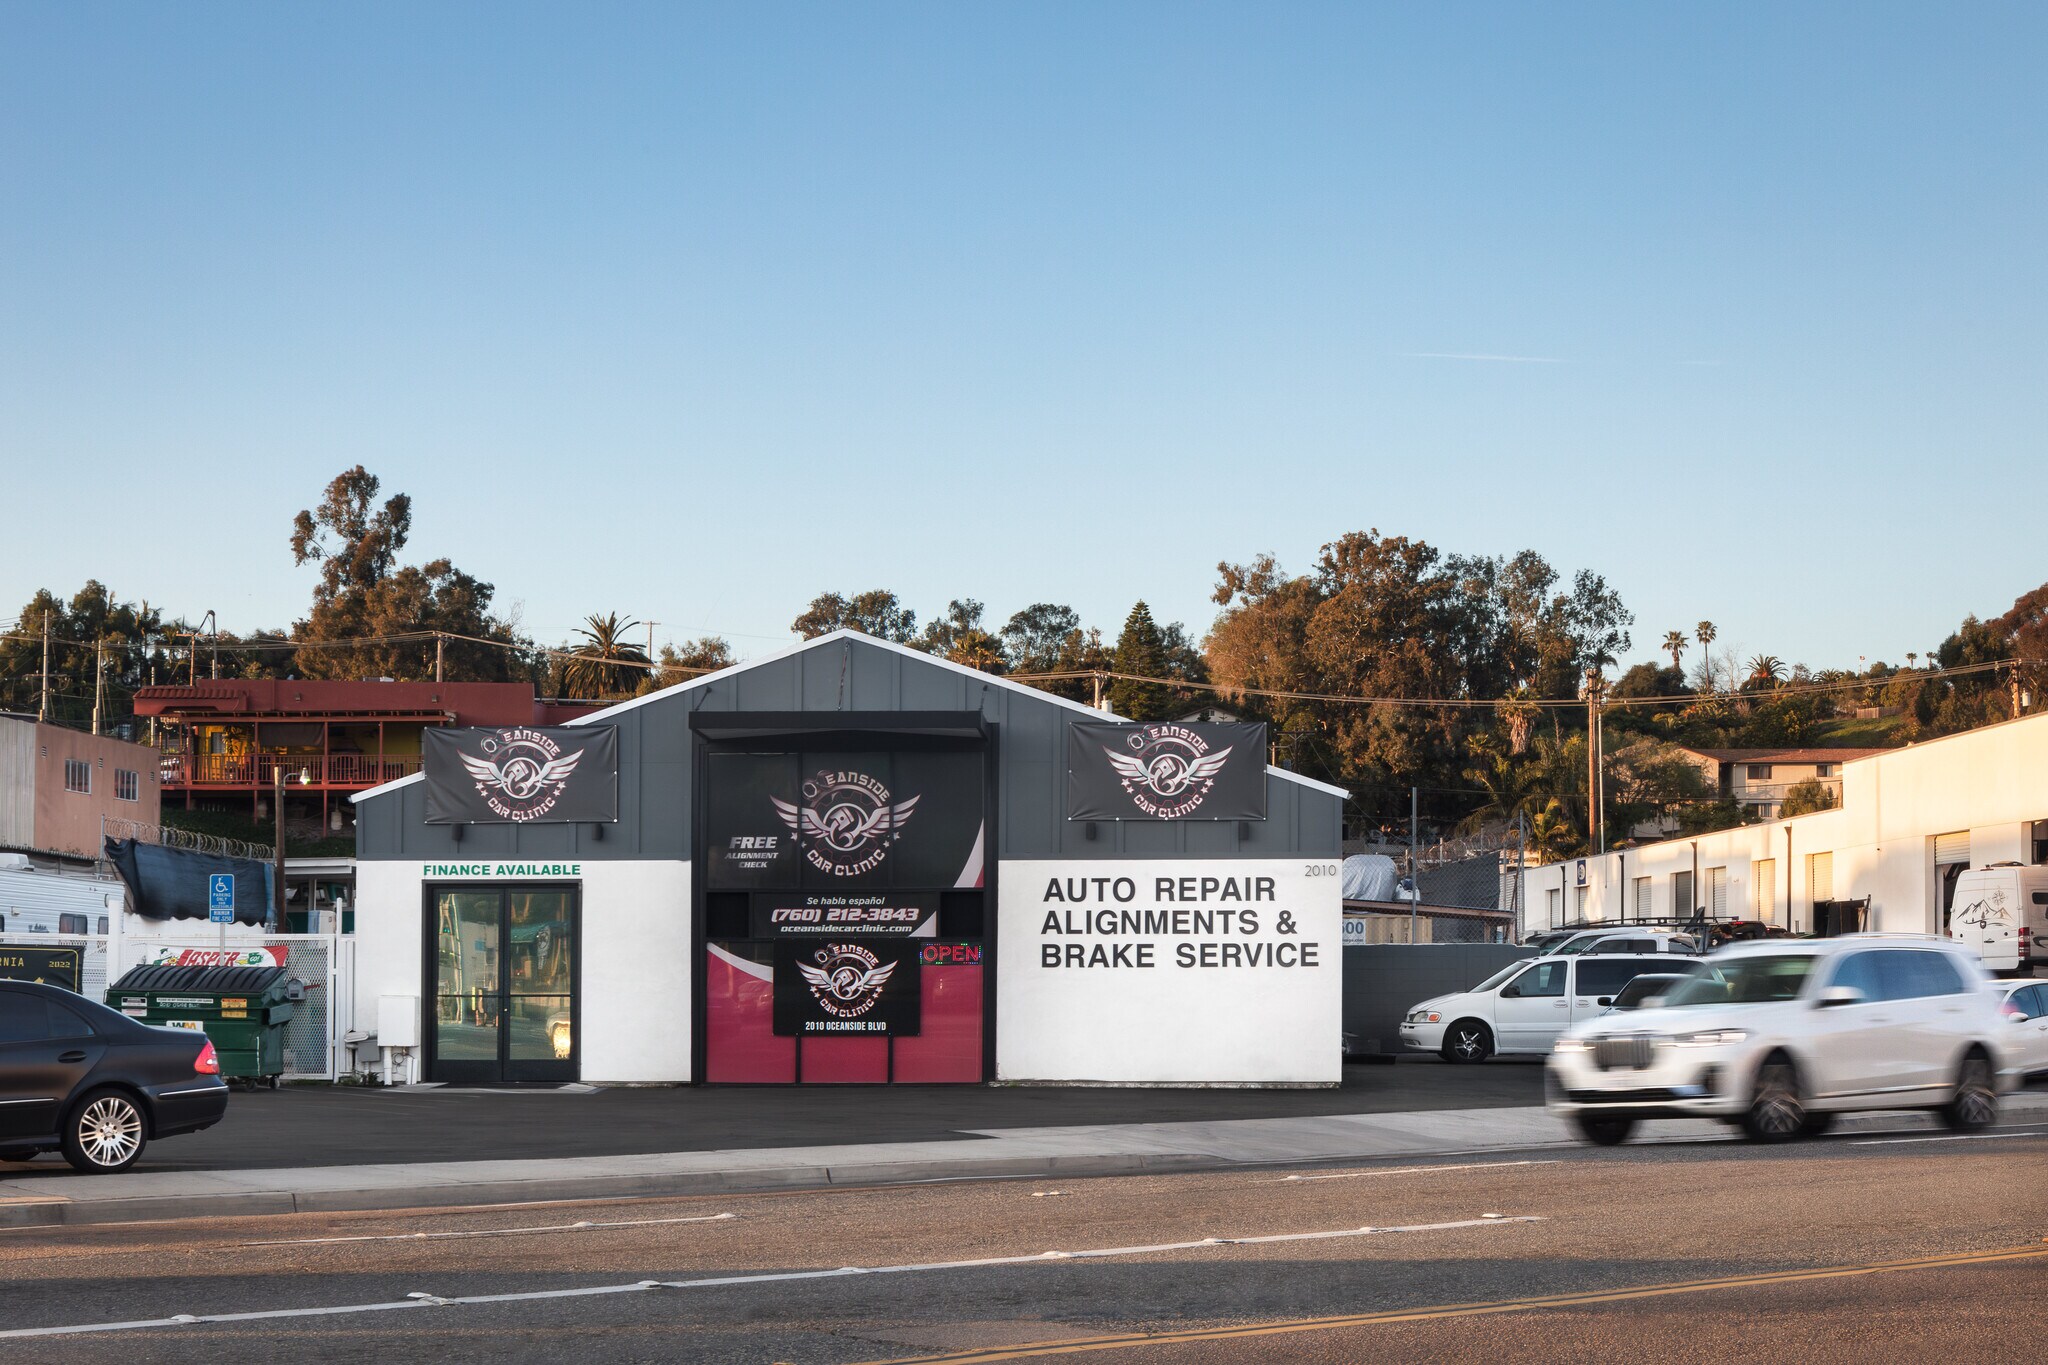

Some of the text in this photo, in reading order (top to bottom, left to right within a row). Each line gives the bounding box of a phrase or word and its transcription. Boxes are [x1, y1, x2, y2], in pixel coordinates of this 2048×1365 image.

[487, 797, 556, 820] CAR CLINIC
[1133, 794, 1203, 818] CAR CLINIC
[729, 836, 778, 849] FREE
[807, 849, 885, 876] CAR CLINIC
[423, 865, 581, 876] FINANCE AVAILABLE
[1304, 864, 1337, 877] 2010
[1043, 877, 1276, 902] AUTO REPAIR
[807, 896, 885, 906] Se habla español
[771, 908, 919, 923] (760) 212-3843
[1041, 910, 1298, 935] ALIGNMENTS &
[781, 924, 912, 933] oceansidecarclinic.com
[923, 945, 979, 962] OPEN
[1041, 942, 1319, 968] BRAKE SERVICE
[0, 956, 25, 967] NIA
[48, 960, 71, 968] 2022
[819, 998, 875, 1018] CAR CLINIC
[805, 1021, 887, 1031] 2010 OCEANSIDE BLVD
